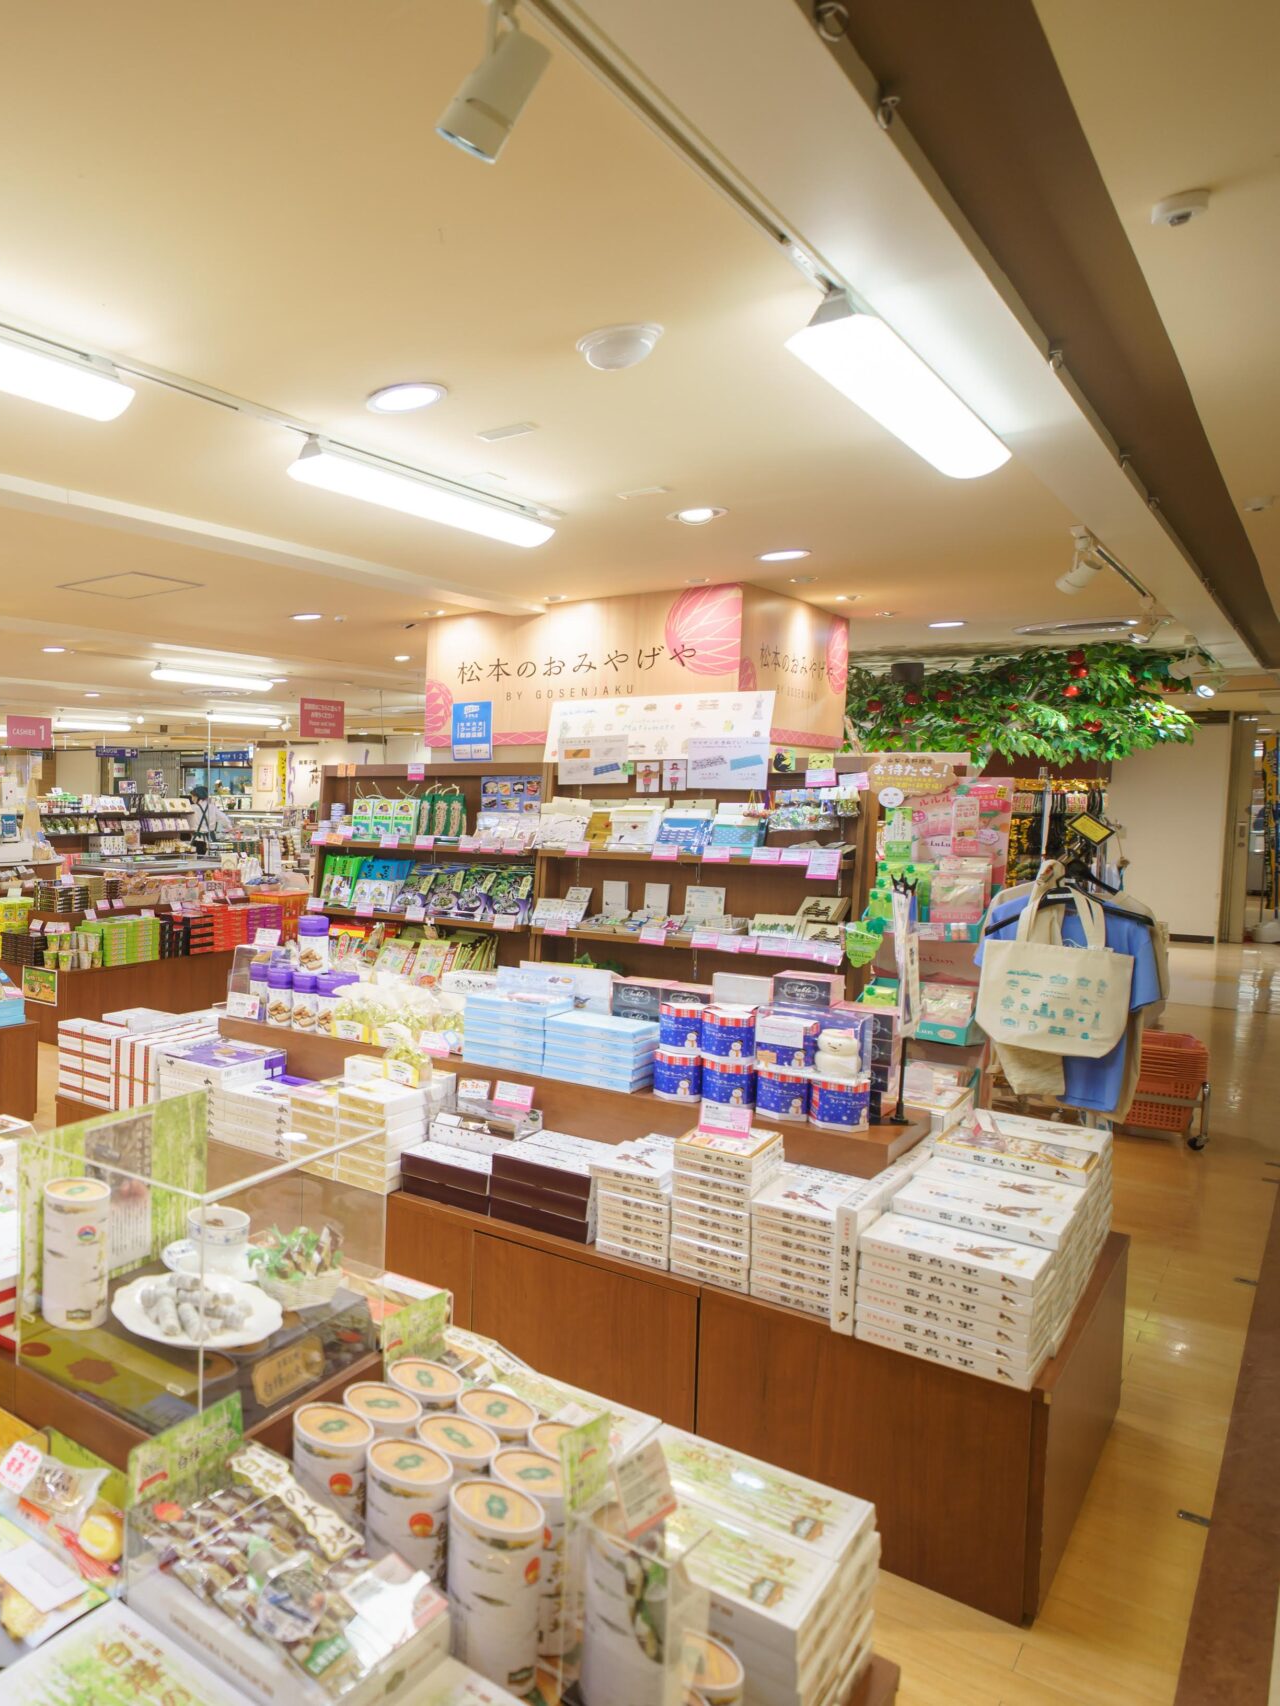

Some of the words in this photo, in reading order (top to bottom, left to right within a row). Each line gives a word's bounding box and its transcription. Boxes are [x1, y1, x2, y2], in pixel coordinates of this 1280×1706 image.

[457, 644, 697, 685] 松本のおみやげや
[760, 642, 834, 684] 松本のおみやげや
[506, 692, 523, 700] BY
[536, 684, 635, 699] GOSENJAKU
[12, 728, 36, 736] CASHIER
[40, 725, 45, 741] 1
[873, 764, 948, 778] お待たせっ!
